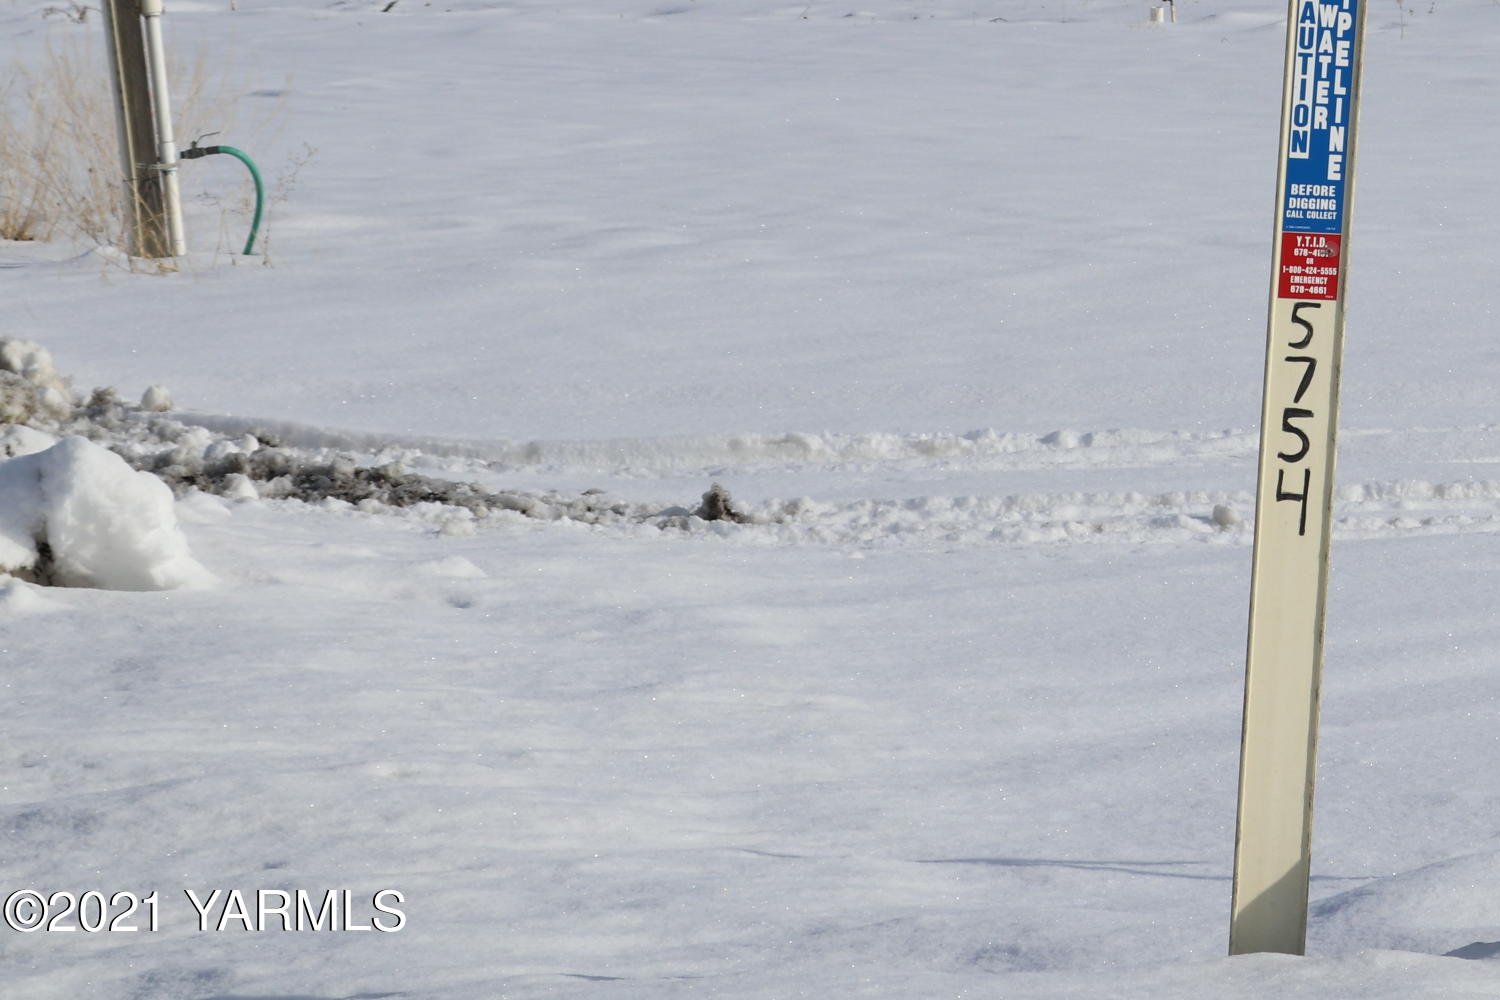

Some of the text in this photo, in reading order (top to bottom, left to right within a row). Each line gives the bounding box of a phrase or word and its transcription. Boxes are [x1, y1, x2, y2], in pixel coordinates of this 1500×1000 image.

[1313, 4, 1339, 130] WATER
[1290, 183, 1336, 197] BEFORE
[1288, 197, 1336, 211] DIGGING
[1286, 209, 1337, 220] CALL COLLECT
[1296, 235, 1328, 248] Y.T.I.D.
[1305, 257, 1314, 265] OR
[1282, 265, 1337, 276] 1-800-424-5555
[1290, 275, 1328, 285] EMERGENCY
[1275, 301, 1322, 536] 5754
